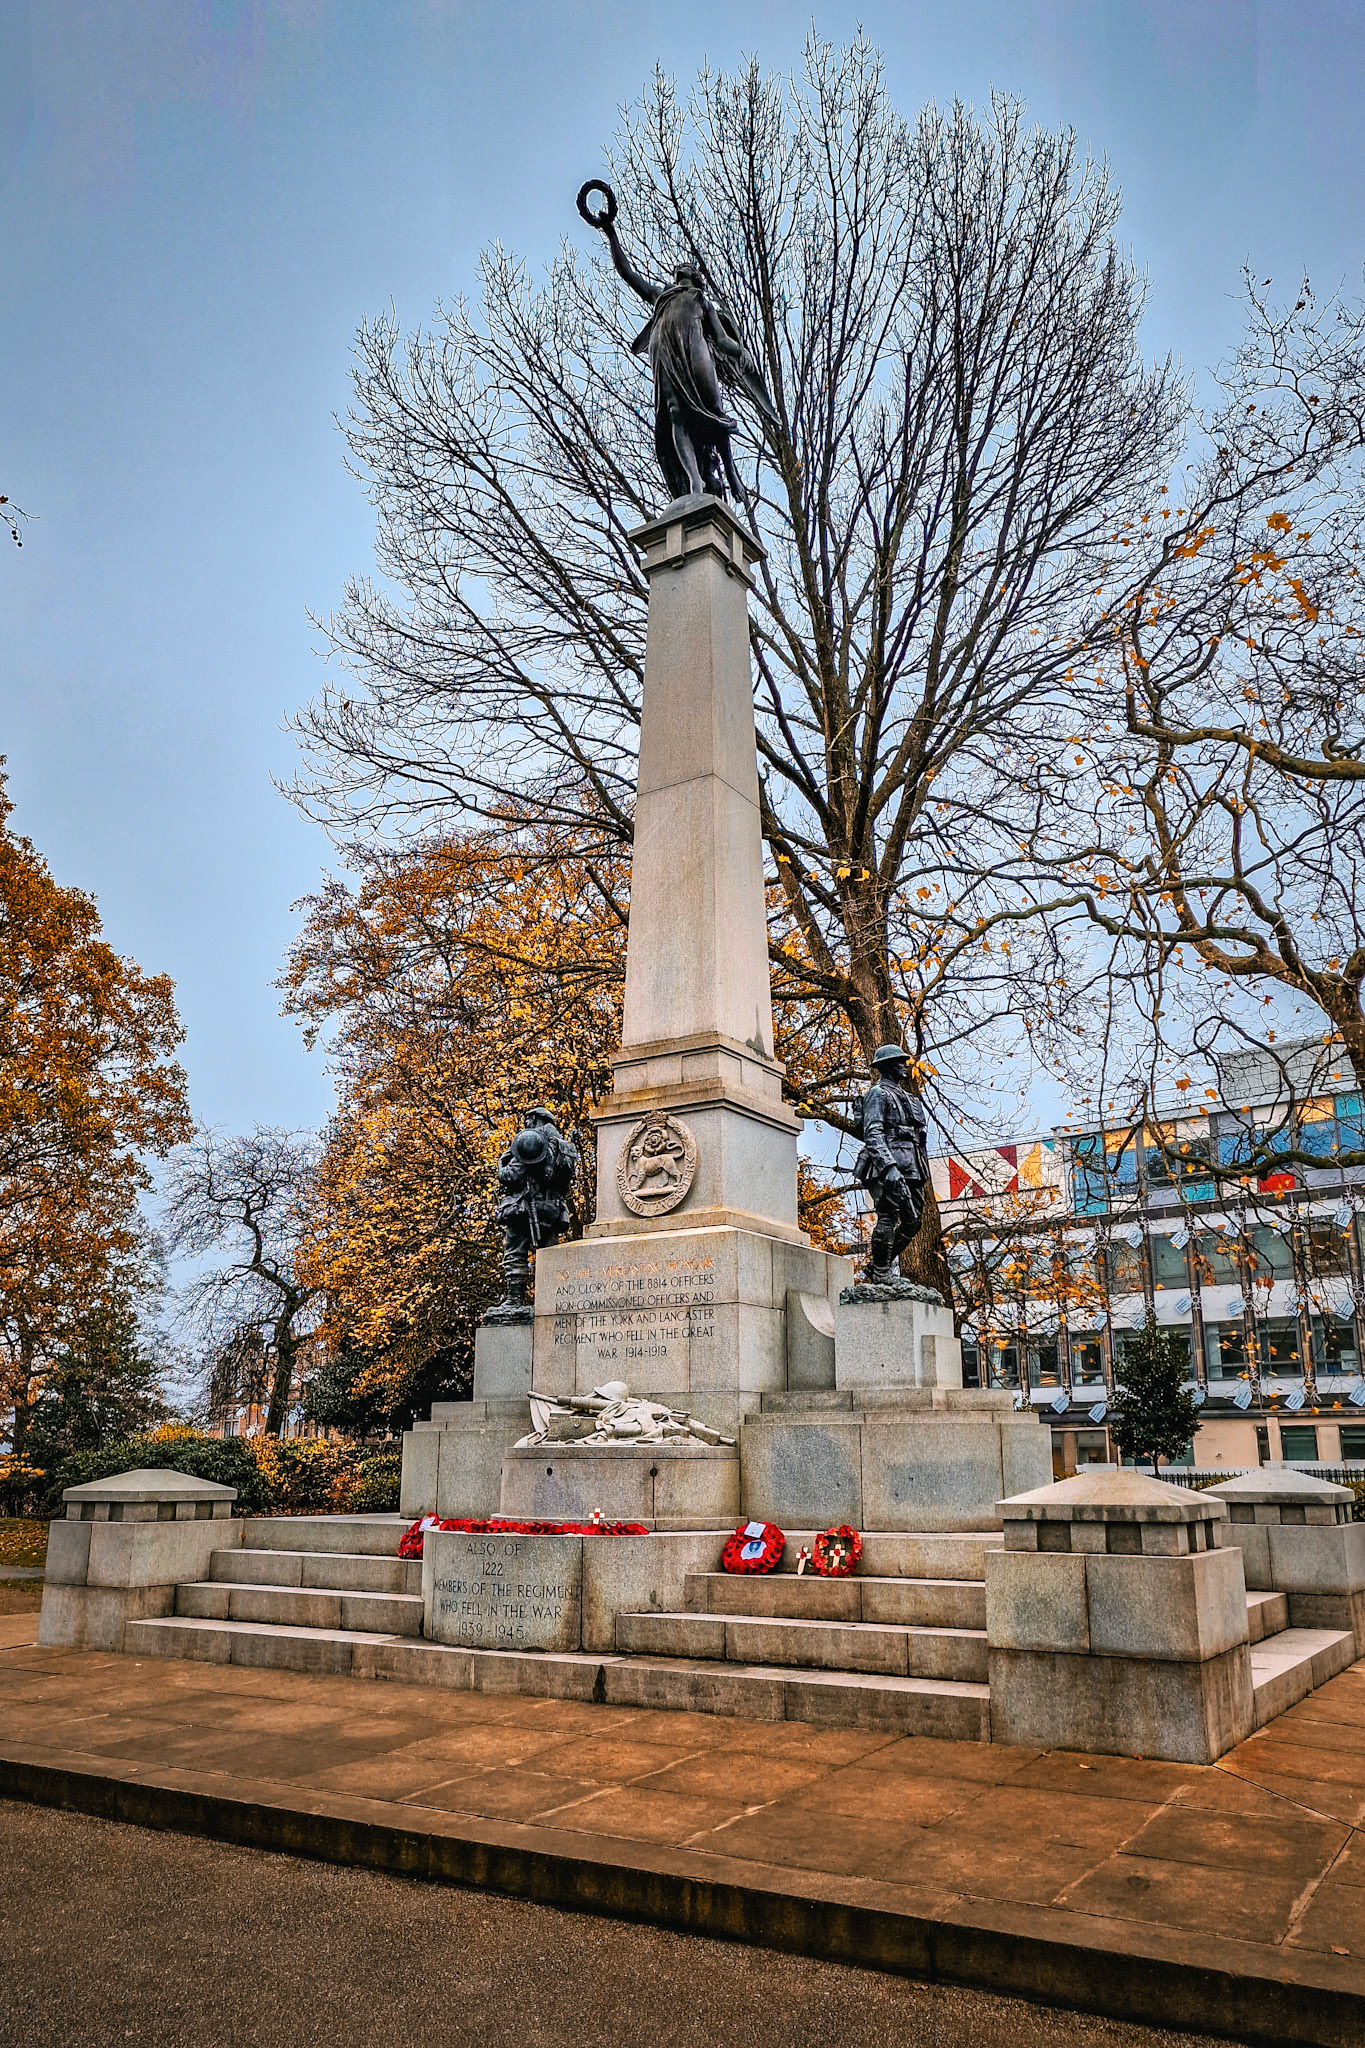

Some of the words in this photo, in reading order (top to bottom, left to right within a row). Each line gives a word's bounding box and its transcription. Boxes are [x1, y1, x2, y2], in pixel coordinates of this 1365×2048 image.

[556, 1269, 570, 1281] TO
[573, 1267, 593, 1279] THE
[667, 1256, 716, 1272] HONOUR
[556, 1284, 576, 1297] AND
[578, 1282, 607, 1295] GLORY
[610, 1280, 624, 1292] OF
[626, 1279, 645, 1291] THE
[647, 1277, 668, 1290] 8814
[670, 1273, 715, 1288] OFFICERS
[647, 1292, 690, 1307] OFFICERS
[692, 1290, 715, 1303] AND
[554, 1317, 572, 1330] MEN
[574, 1317, 588, 1328] OF
[589, 1315, 607, 1327] THE
[610, 1313, 634, 1326] YORK
[636, 1312, 657, 1324] AND
[659, 1308, 715, 1323] LANCASTER
[554, 1331, 598, 1346] REGIMENT
[599, 1330, 624, 1343] WHO
[626, 1329, 645, 1341] FELL
[647, 1328, 658, 1340] IN
[660, 1327, 679, 1340] THE
[681, 1325, 715, 1339] GREAT
[597, 1346, 618, 1359] WAR
[466, 1541, 496, 1556] ALSO
[504, 1542, 523, 1557] OF
[482, 1561, 504, 1577] 1222
[434, 1578, 468, 1595] MEMBERS
[471, 1581, 487, 1596] OF
[491, 1582, 512, 1598] THE
[517, 1584, 582, 1600] REGIMENT
[440, 1599, 459, 1614] WHO
[461, 1600, 483, 1617] FELL
[487, 1602, 499, 1617] IN
[502, 1603, 526, 1619] THE
[531, 1605, 563, 1620] WAR
[458, 1620, 484, 1638] 1939
[494, 1624, 525, 1641] 1945
